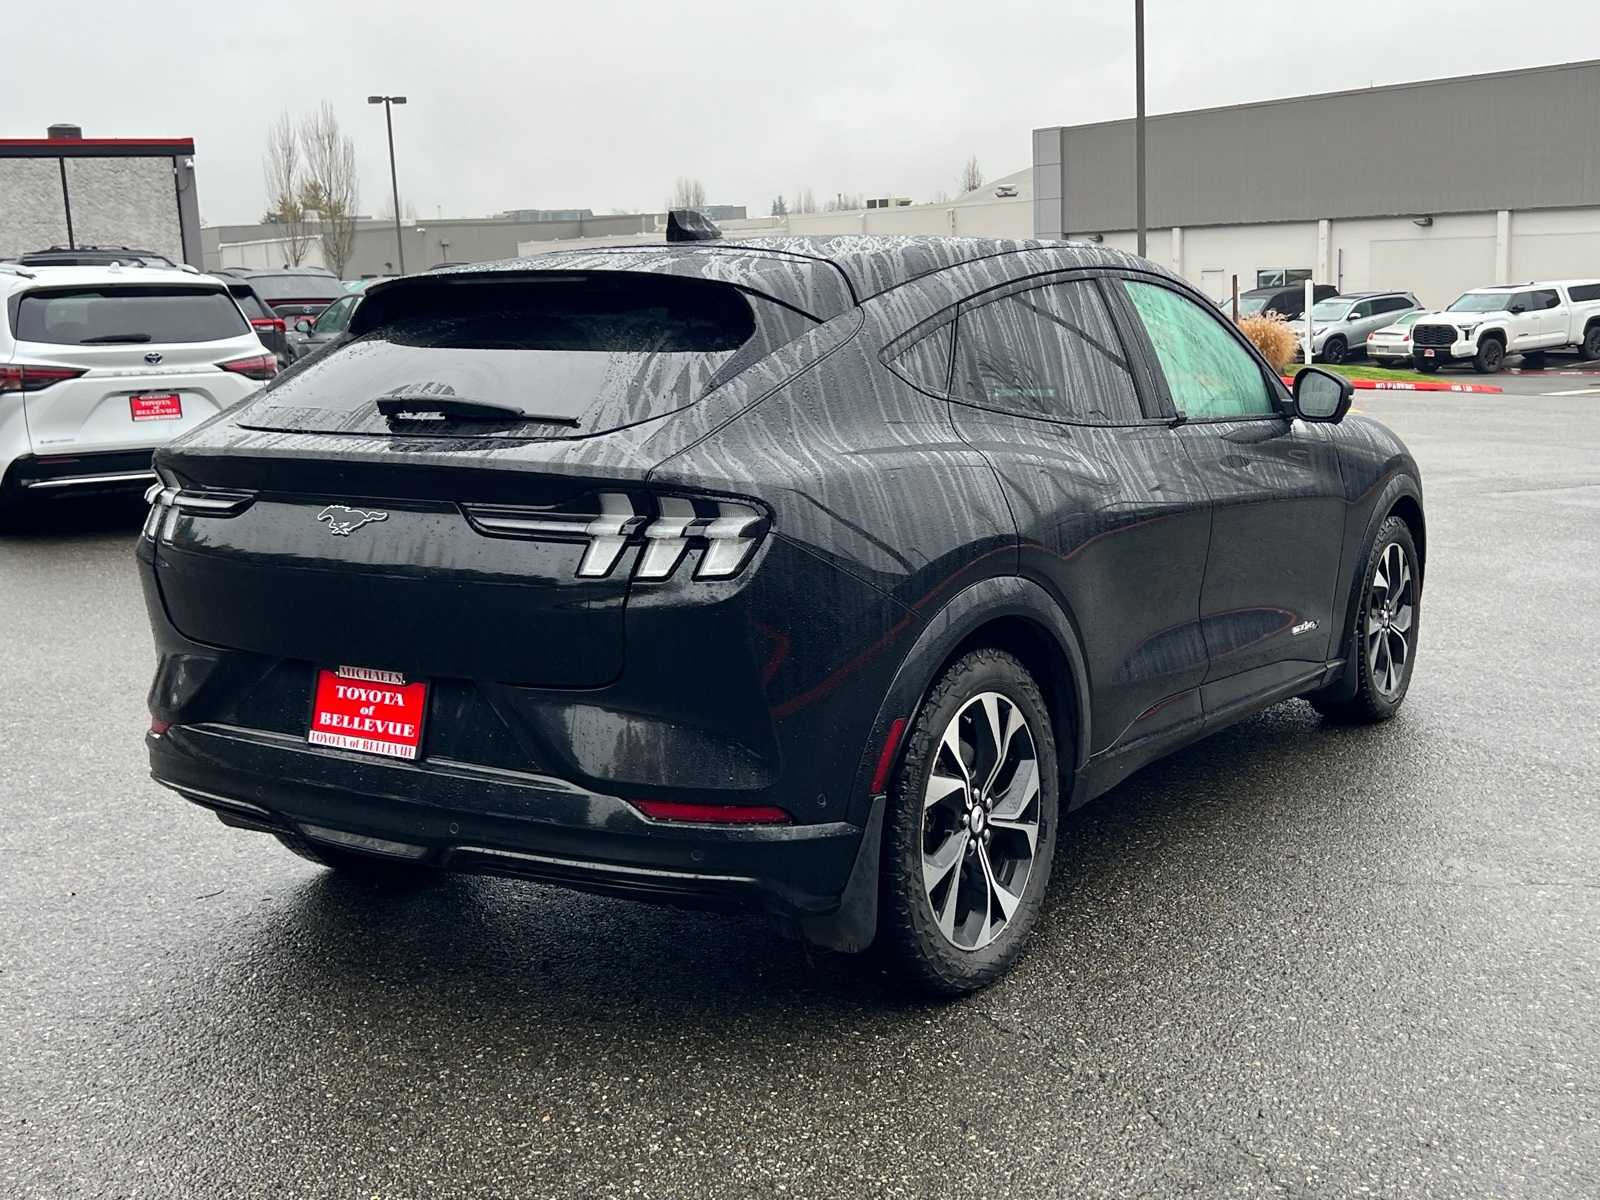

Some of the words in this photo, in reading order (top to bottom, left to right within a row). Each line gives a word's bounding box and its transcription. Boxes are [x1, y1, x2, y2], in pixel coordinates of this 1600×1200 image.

[336, 685, 405, 706] TOYOTA
[360, 706, 375, 716] of
[319, 712, 415, 737] BELLEVUE
[310, 732, 347, 747] TOYOTA
[350, 738, 361, 748] of
[362, 741, 414, 757] BELLEVUE
